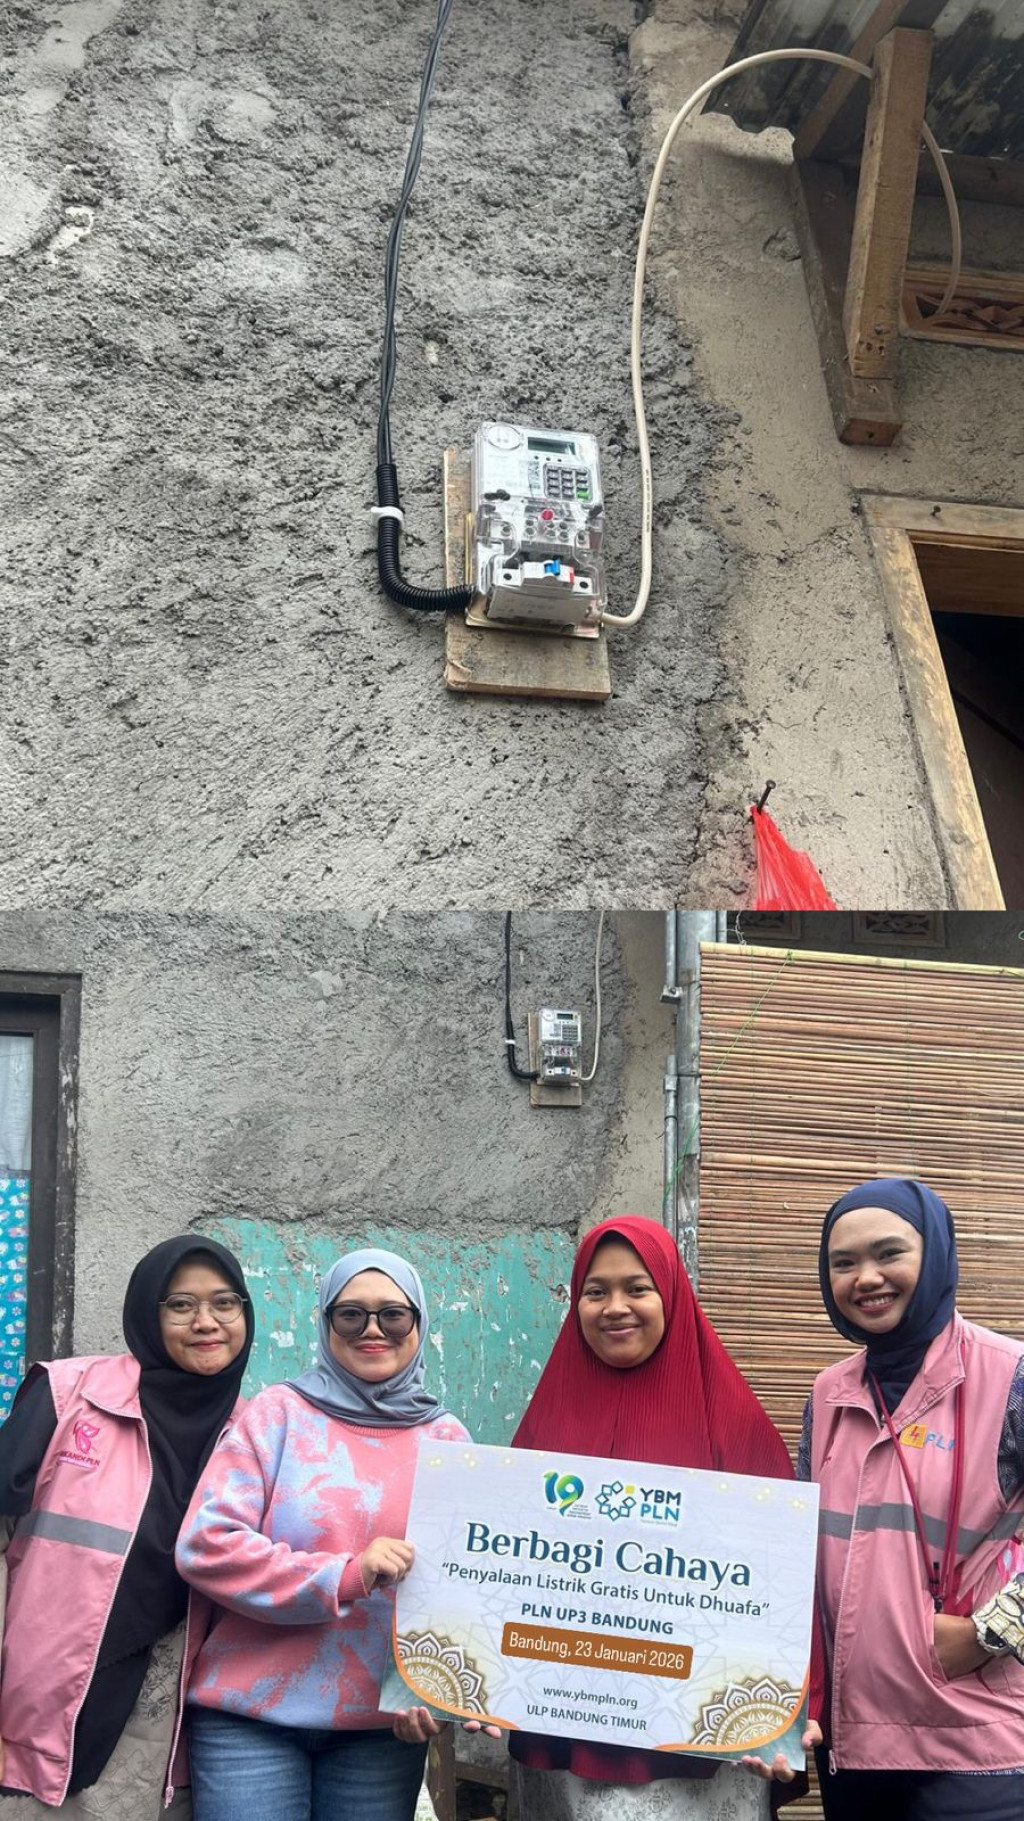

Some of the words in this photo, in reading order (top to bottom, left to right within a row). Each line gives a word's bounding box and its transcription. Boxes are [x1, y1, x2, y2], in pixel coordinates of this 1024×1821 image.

[543, 1471, 584, 1516] 19
[640, 1487, 681, 1506] YBM
[640, 1503, 680, 1522] PLN
[466, 1522, 604, 1574] Berbagi
[616, 1541, 751, 1591] Cahaya
[537, 1573, 586, 1594] Listrik
[590, 1581, 639, 1600] Gratis
[644, 1587, 695, 1608] Untuk
[521, 1603, 552, 1618] PLN
[556, 1607, 587, 1623] UP3
[591, 1612, 674, 1635] BANDUNG
[509, 1631, 571, 1658] Bandung,
[575, 1640, 593, 1658] 23
[594, 1643, 648, 1665] Januari
[649, 1650, 685, 1670] 2026
[543, 1686, 638, 1709] www.ybmpln.org
[527, 1704, 548, 1717] ULP
[551, 1708, 608, 1726] BANDUNG
[611, 1715, 647, 1730] TIMUR
